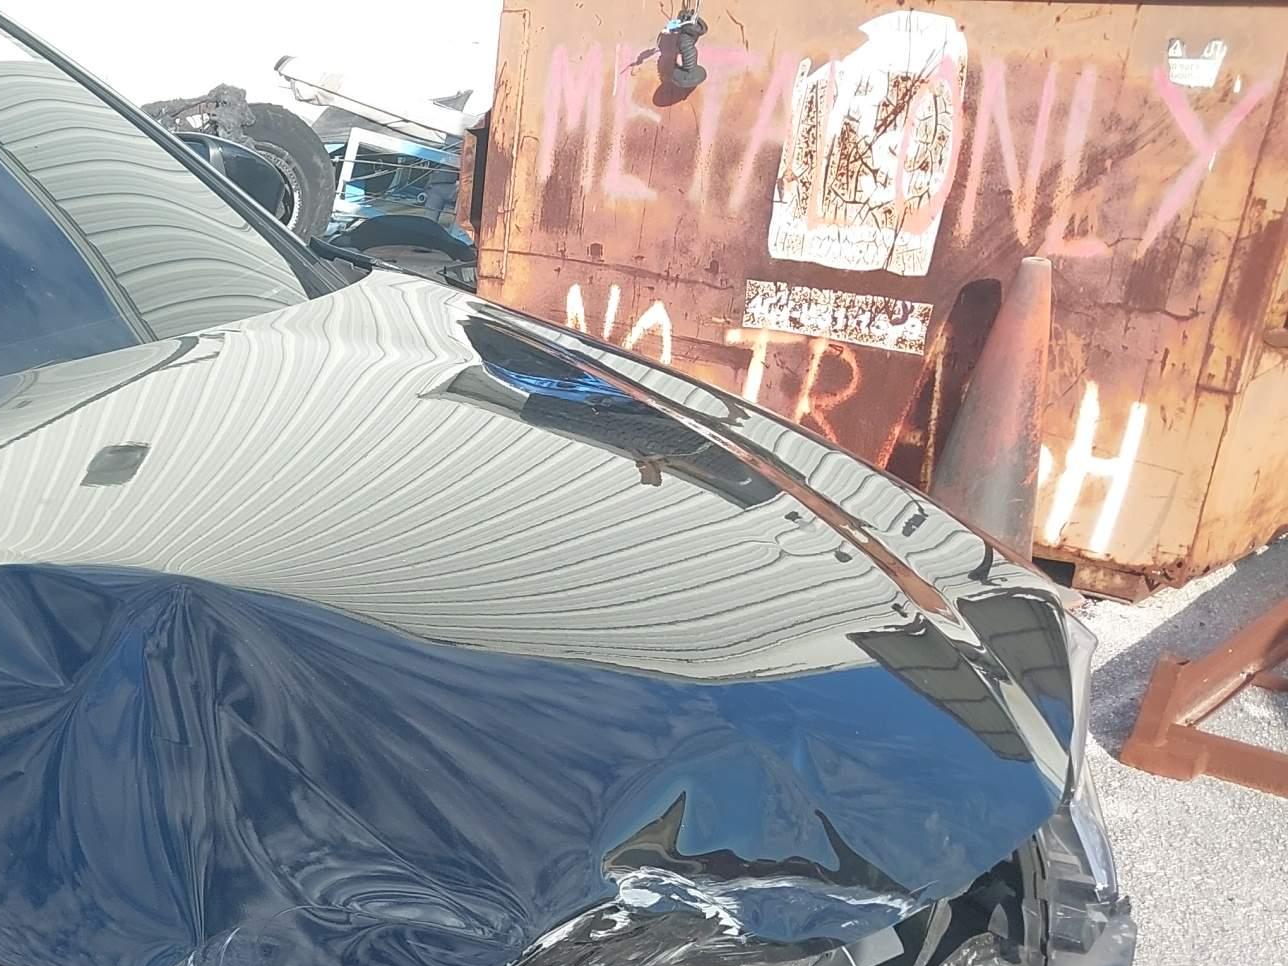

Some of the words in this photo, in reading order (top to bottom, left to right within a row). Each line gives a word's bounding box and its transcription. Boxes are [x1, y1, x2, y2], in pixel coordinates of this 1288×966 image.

[538, 43, 872, 232] METAL
[894, 50, 1278, 262] ONLY
[725, 320, 1177, 561] TRAH
